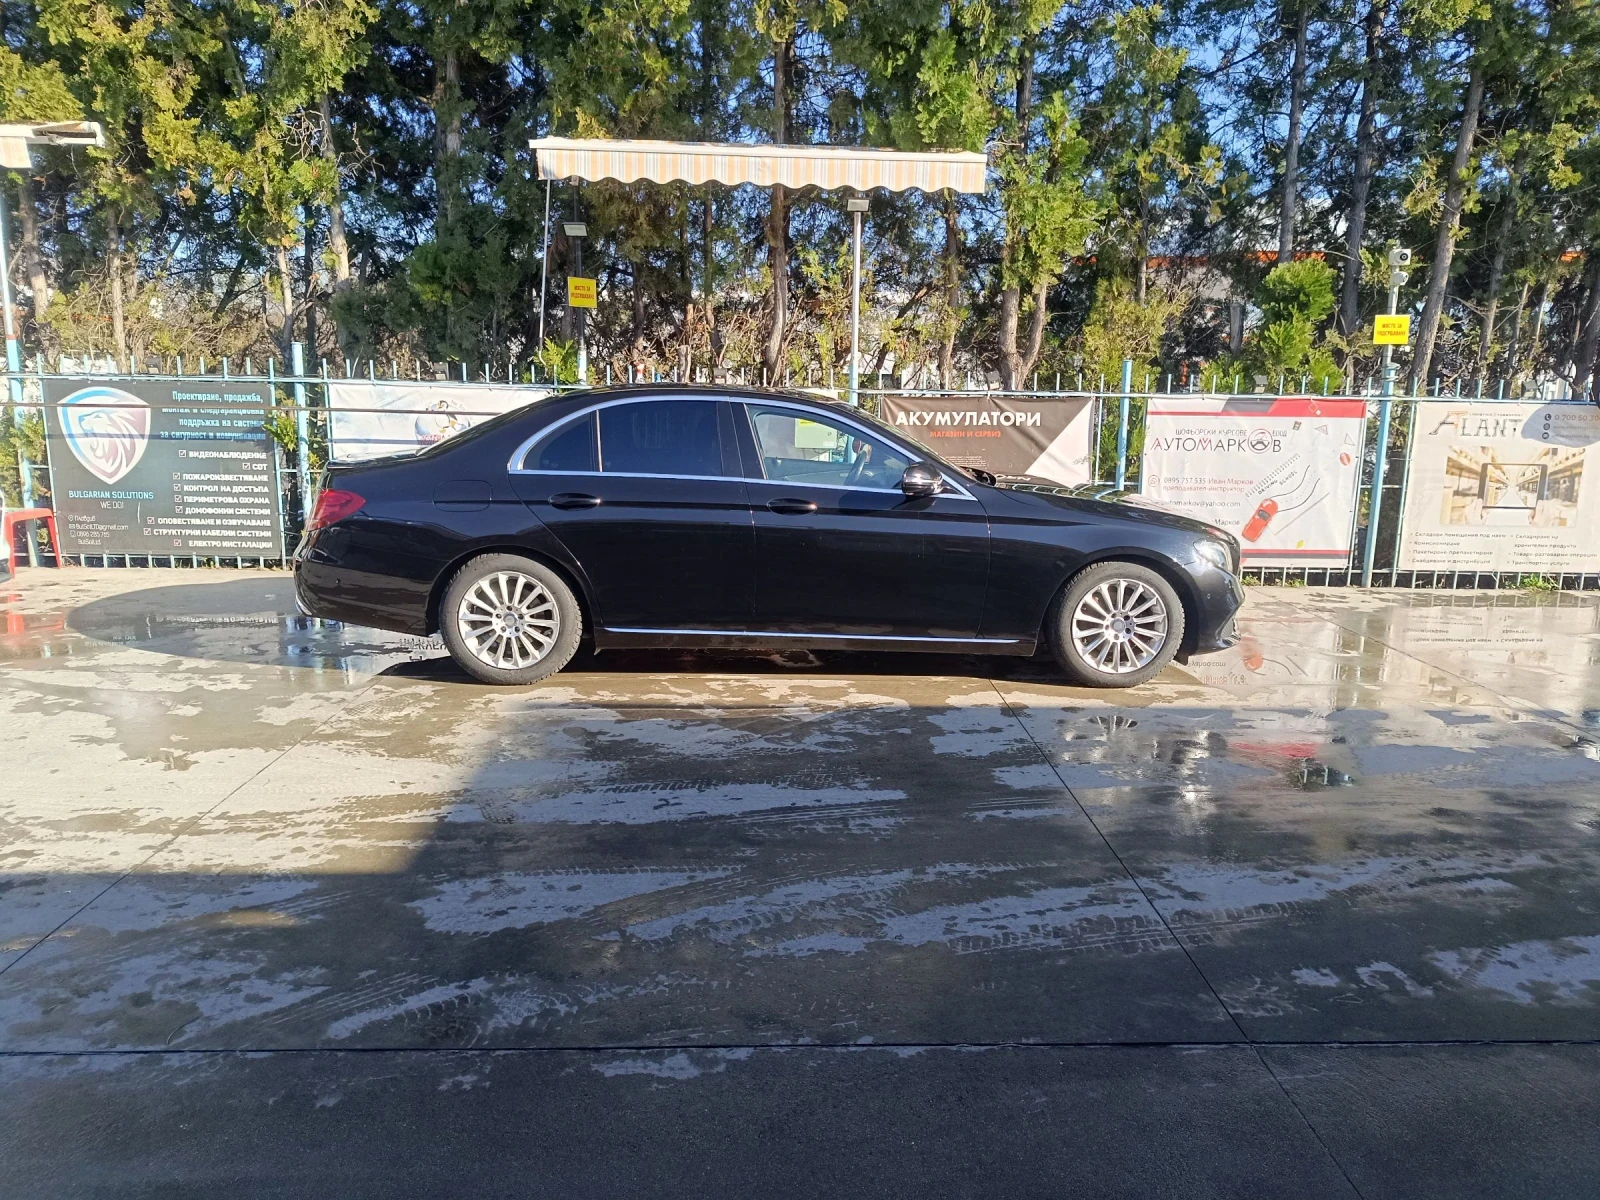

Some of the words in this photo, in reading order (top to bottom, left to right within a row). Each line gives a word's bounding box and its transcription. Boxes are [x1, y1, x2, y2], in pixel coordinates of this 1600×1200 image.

[172, 391, 222, 402] Проектиране,
[223, 393, 264, 403] продажба,
[179, 418, 220, 428] поддръжка
[895, 411, 1041, 427] АКУМУЛАТОРИ
[170, 431, 207, 440] сигурност
[929, 430, 965, 438] МАГАЗИН
[966, 430, 973, 438] И
[974, 430, 1002, 438] СЕРВИЗ
[1175, 428, 1217, 436] ШОФЬОРСКИ
[188, 451, 268, 460] ВИДЕОНАБЛЮДЕНИЕ
[252, 463, 268, 471] СОТ
[183, 473, 269, 482] ПОЖАРОИЗВЕСТЯВАНЕ
[1227, 478, 1254, 486] Марков
[232, 486, 270, 494] ДОСТЪПА
[68, 490, 110, 499] BULGARIAN
[112, 491, 154, 500] SOLUTIONS
[183, 495, 239, 504] ПЕРИМЕТРОВА
[239, 496, 271, 504] ОХРАНА
[100, 501, 111, 509] WE
[185, 506, 235, 515] ДОМОФОННИ
[235, 507, 271, 515] СИСТЕМИ
[157, 517, 215, 526] ОПОВЕСТЯВАНЕ
[216, 518, 222, 526] И
[222, 518, 271, 527] ОЗВУЧАВАНЕ
[153, 528, 201, 536] СТРУКТУРНИ
[201, 529, 236, 537] КАБЕЛНИ
[237, 529, 271, 538] СИСТЕМИ
[188, 540, 220, 548] ЕЛЕКТРО
[222, 540, 273, 549] ИНСТАЛАЦИИ
